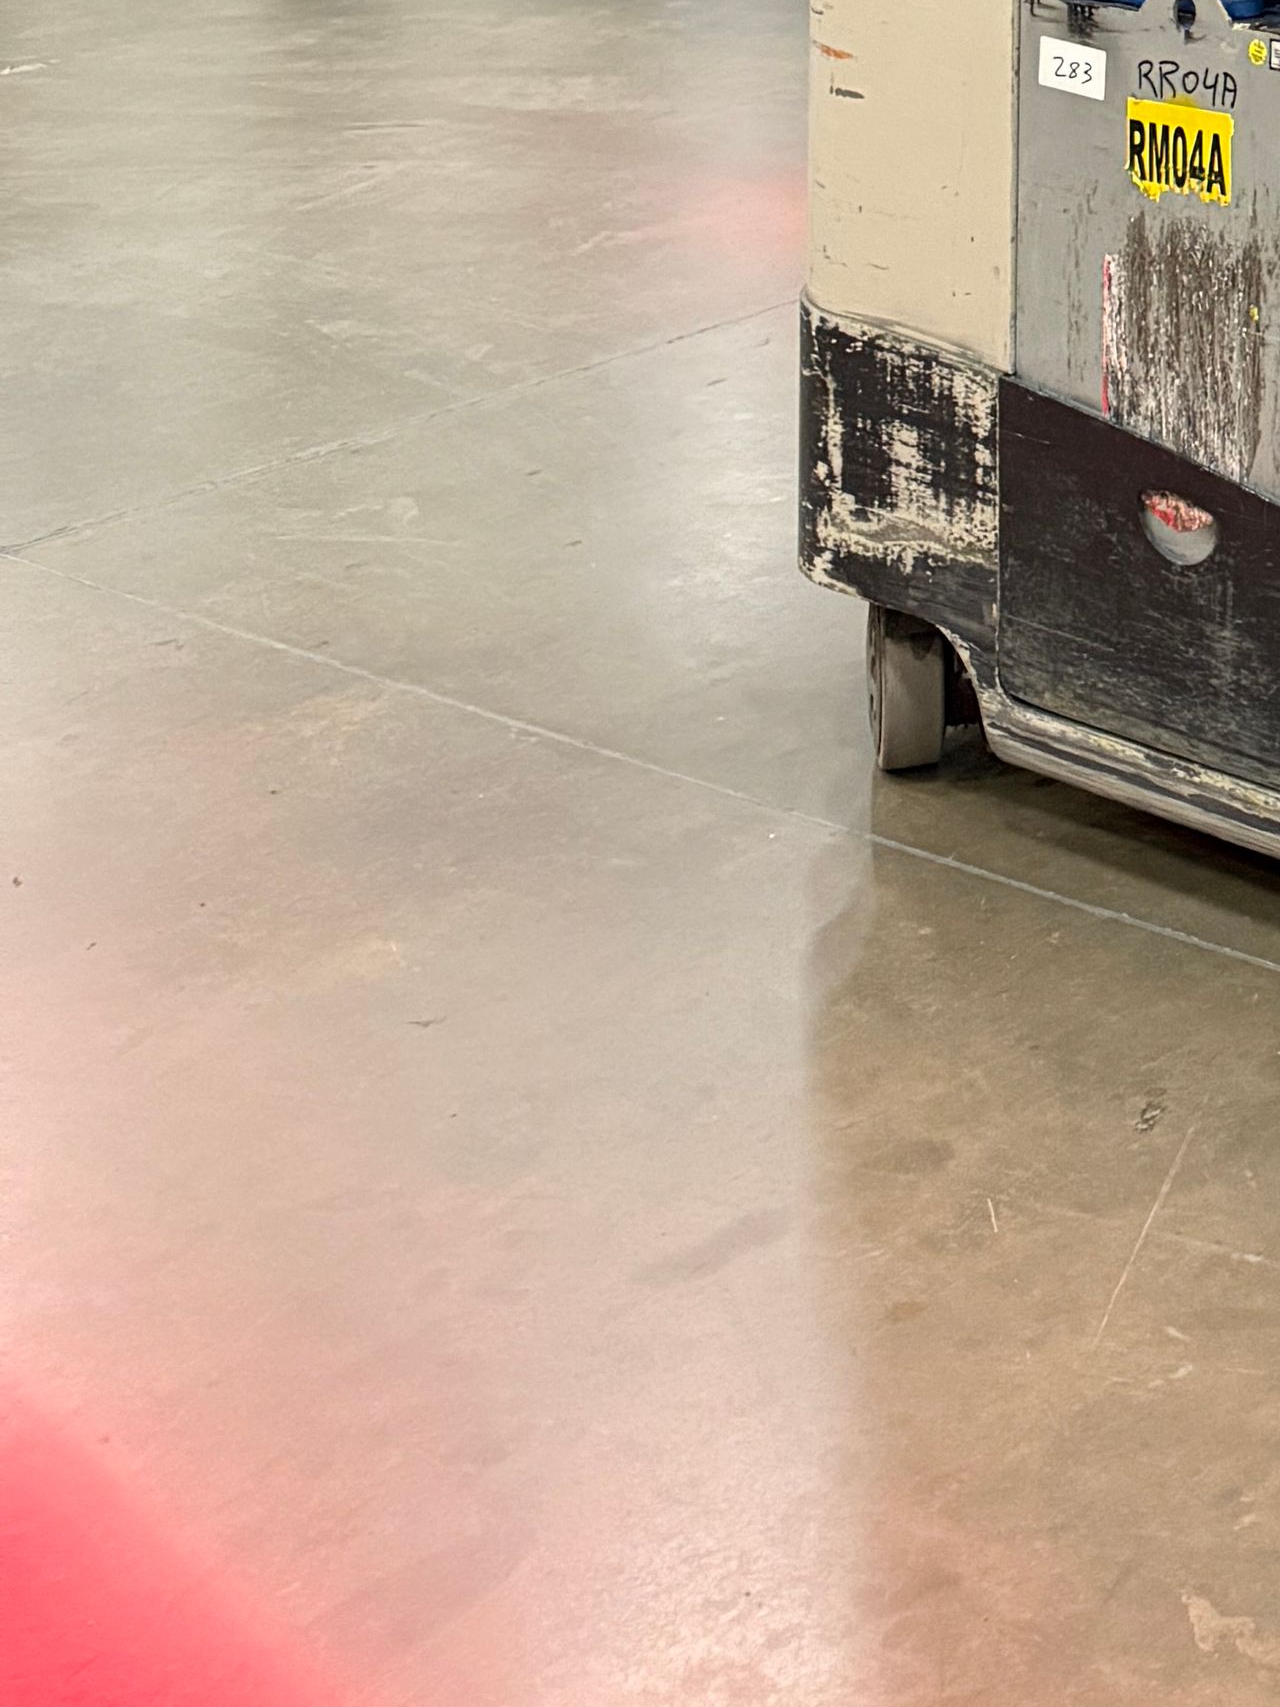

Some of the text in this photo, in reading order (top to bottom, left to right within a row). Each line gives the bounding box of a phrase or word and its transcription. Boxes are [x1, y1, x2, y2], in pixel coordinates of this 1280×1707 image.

[1053, 56, 1093, 84] 283
[1138, 60, 1238, 108] RR04A
[1129, 119, 1227, 196] RM04A
